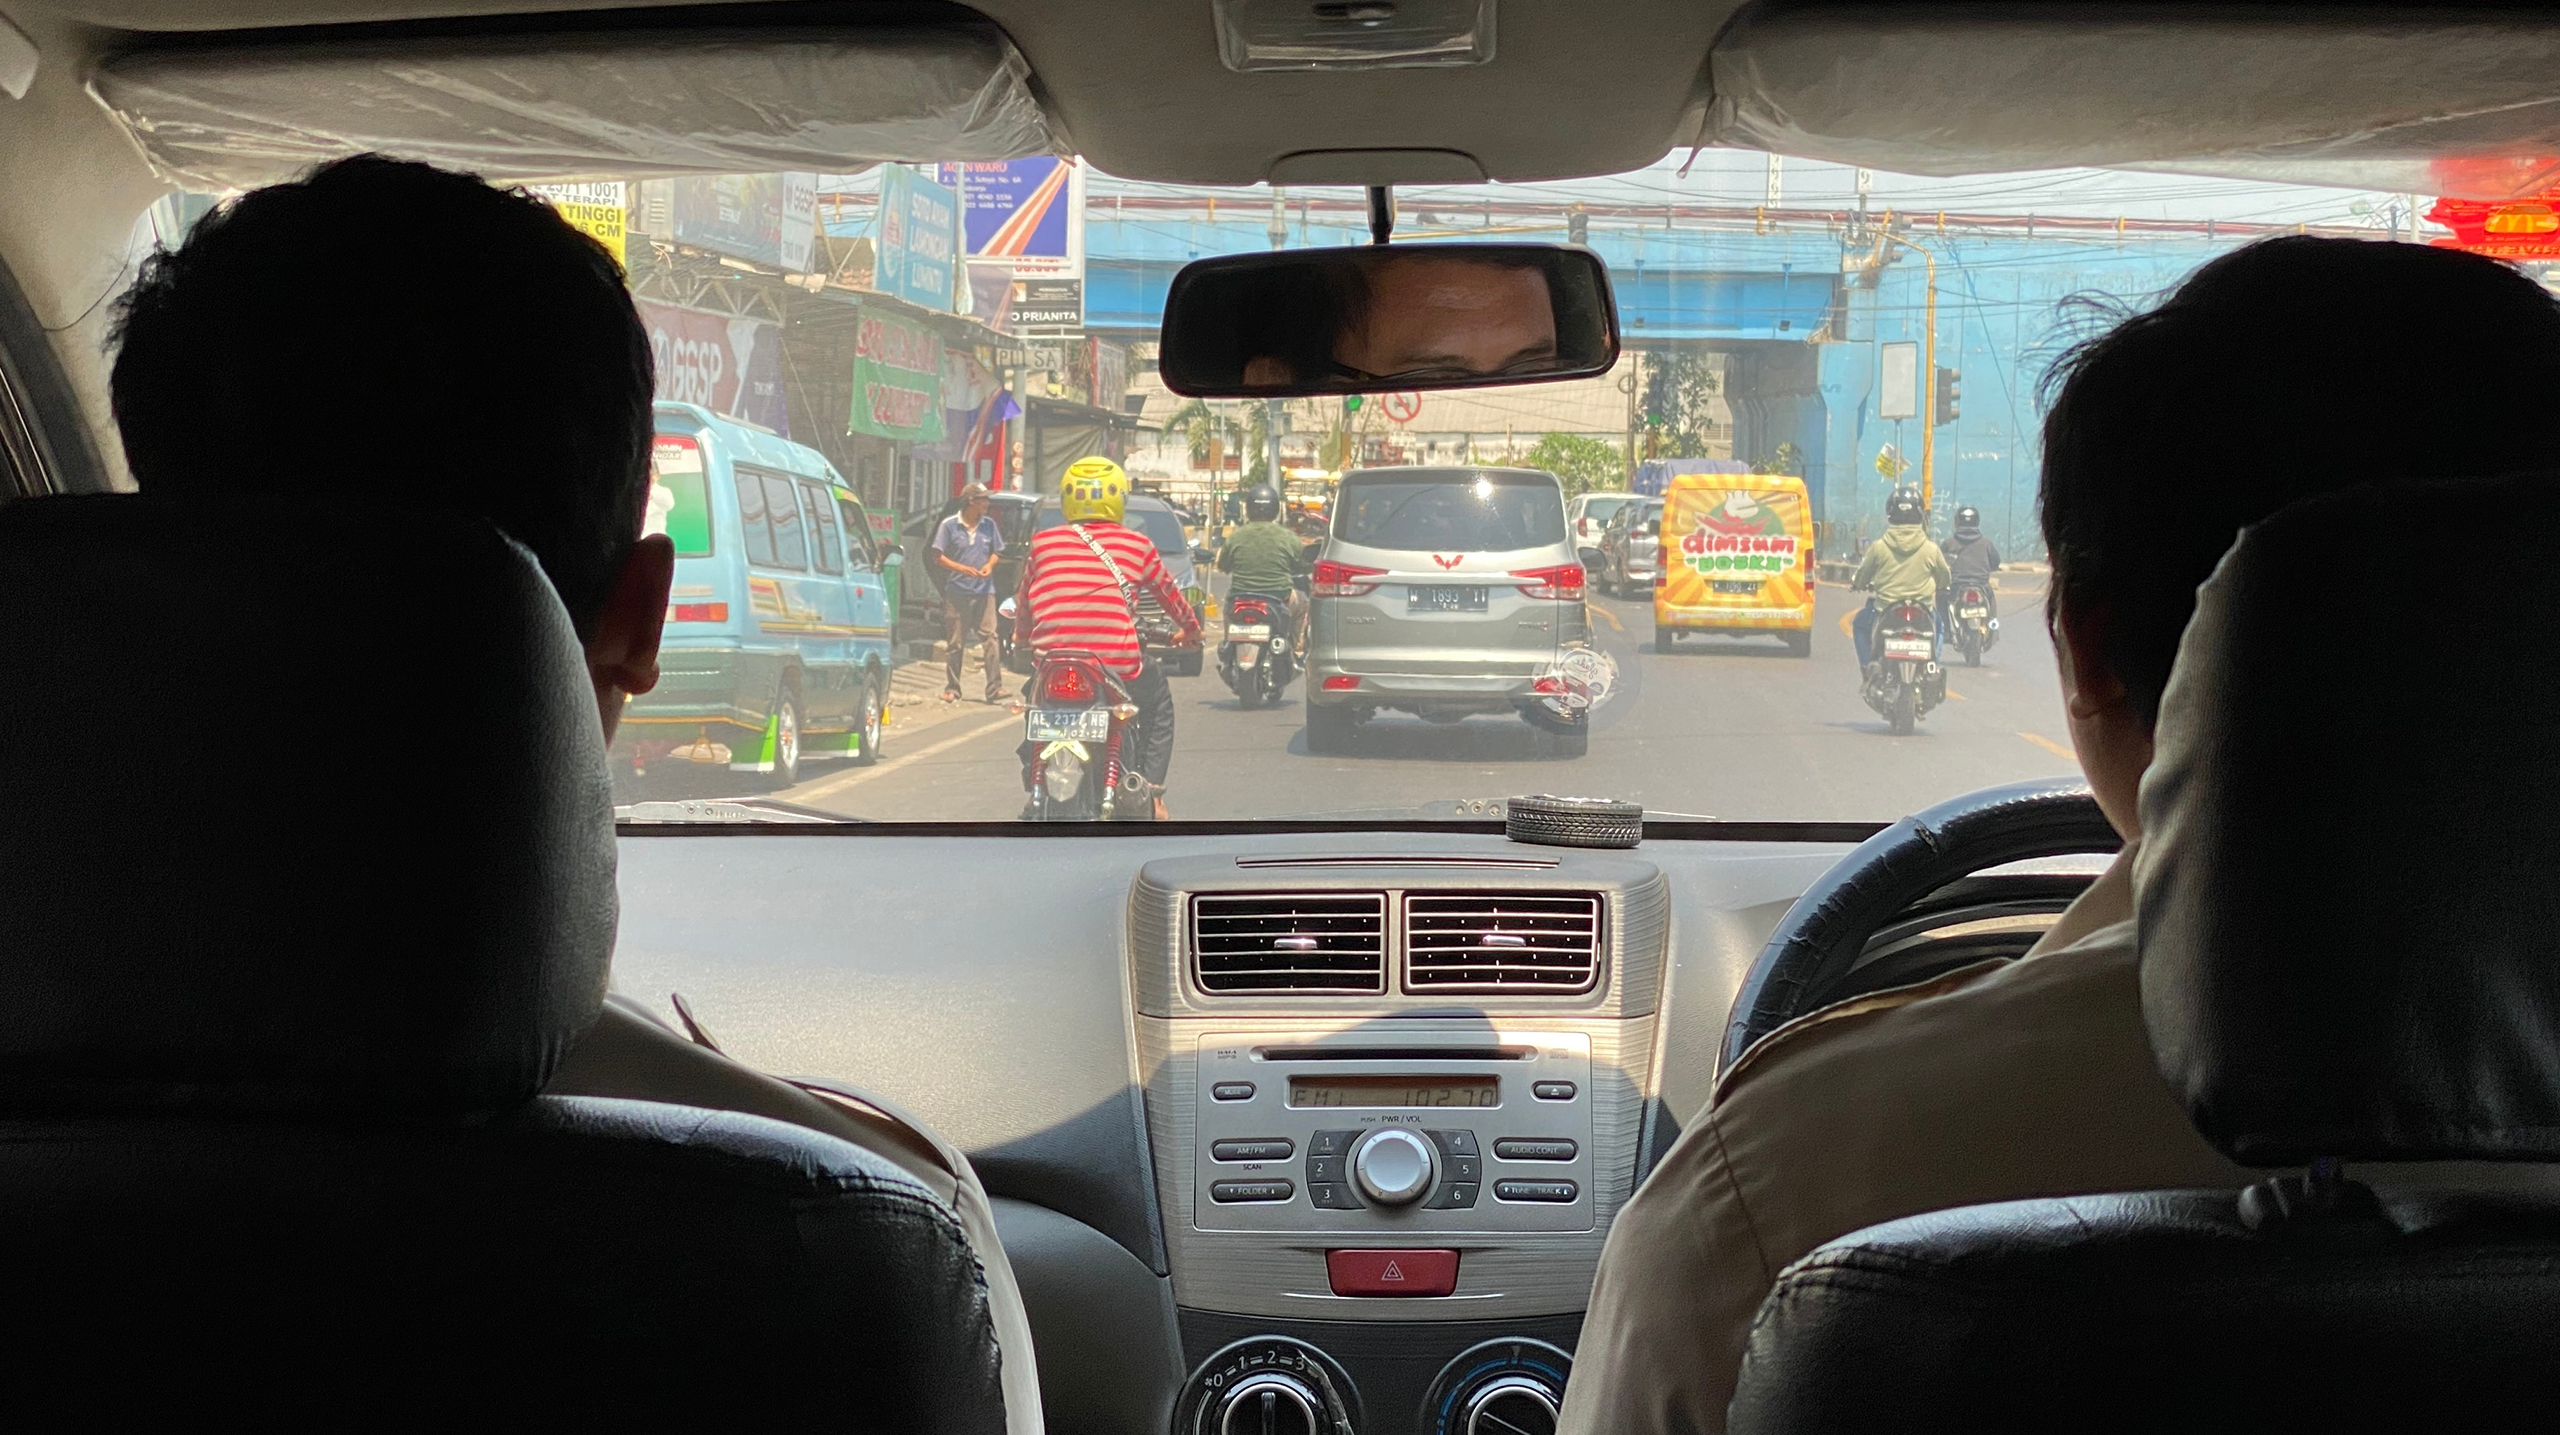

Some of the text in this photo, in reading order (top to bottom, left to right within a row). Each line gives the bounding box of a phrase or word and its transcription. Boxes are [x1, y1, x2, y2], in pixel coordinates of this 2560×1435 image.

[974, 162, 1008, 173] WARU
[588, 183, 618, 198] 1001
[563, 194, 616, 206] TERAPI
[565, 204, 621, 223] TINGGI
[595, 224, 620, 238] CM
[1022, 311, 1078, 321] PRIANITA
[672, 337, 723, 408] GGSP
[1431, 588, 1459, 603] 1893
[1032, 713, 1047, 726] AE
[1325, 1137, 1330, 1146] 1
[1454, 1136, 1461, 1146] 4
[1510, 1146, 1535, 1154] AUDIO
[1316, 1163, 1323, 1172] 2
[1462, 1164, 1469, 1174] 5
[1237, 1187, 1267, 1195] FOLDER
[1323, 1189, 1330, 1199] 3
[1453, 1190, 1461, 1200] 6
[1213, 1350, 1305, 1388] 0 1 2 3
